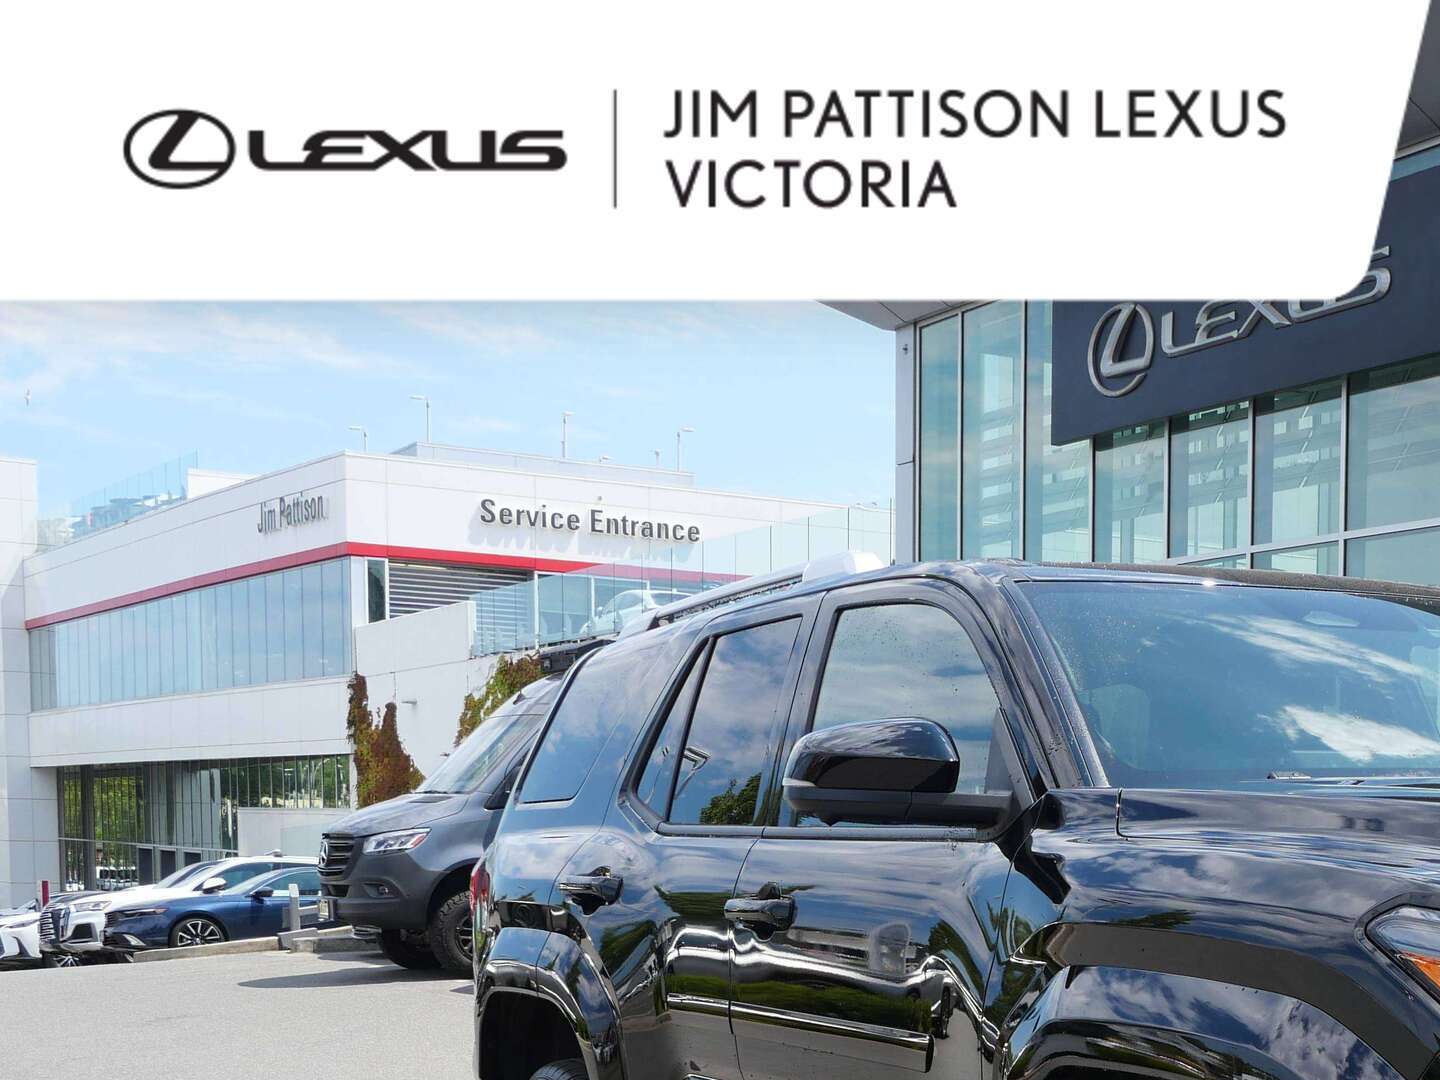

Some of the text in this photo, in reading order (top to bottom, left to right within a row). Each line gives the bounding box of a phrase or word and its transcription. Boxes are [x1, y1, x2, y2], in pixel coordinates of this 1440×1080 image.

[257, 491, 324, 533] Jim Pattison
[480, 499, 700, 542] Service Entrance
